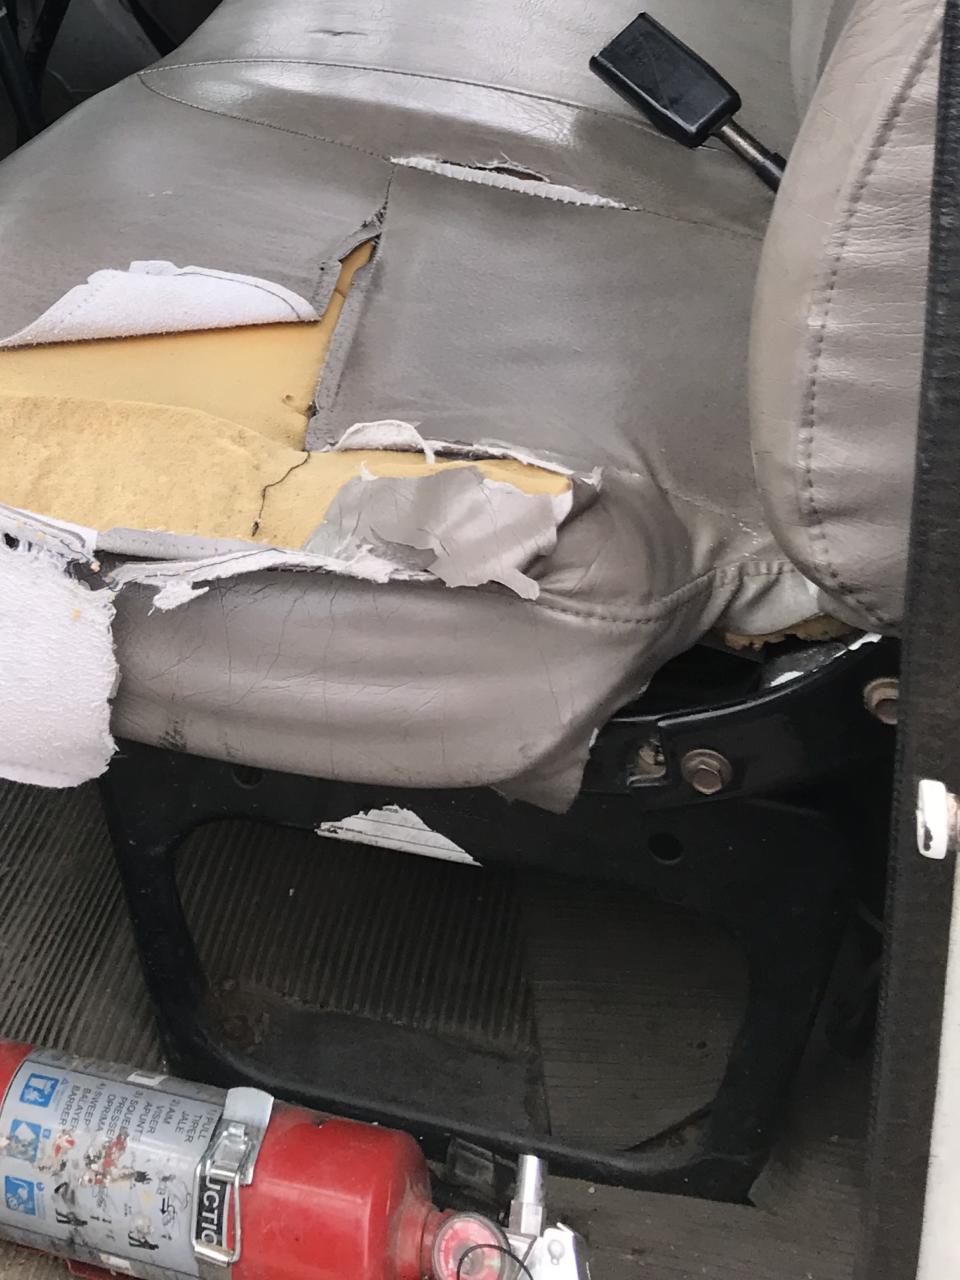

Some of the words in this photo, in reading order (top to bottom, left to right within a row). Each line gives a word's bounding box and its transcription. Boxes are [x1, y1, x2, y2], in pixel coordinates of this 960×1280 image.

[57, 1084, 79, 1126] BARRER
[82, 1089, 102, 1125] SWEEP
[95, 1092, 115, 1132] OPRIMA
[146, 1103, 164, 1134] VISER
[161, 1106, 174, 1124] AIM
[174, 1110, 189, 1134] JALE
[183, 1113, 202, 1143] TIRER
[196, 1115, 212, 1140] PULL
